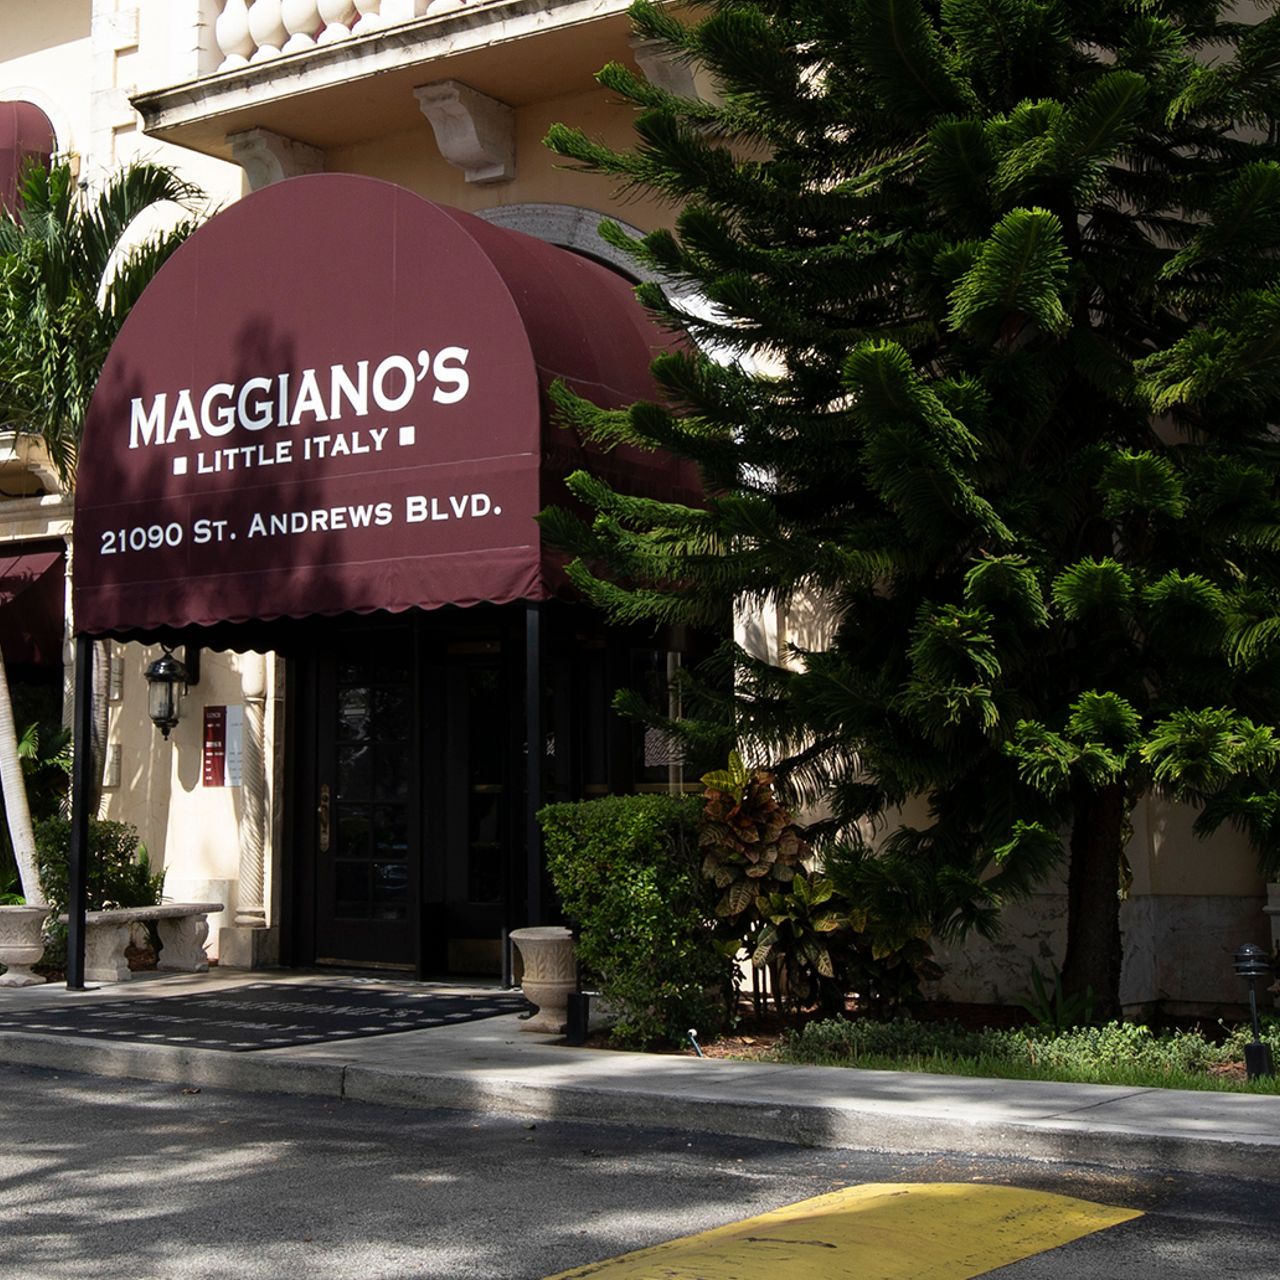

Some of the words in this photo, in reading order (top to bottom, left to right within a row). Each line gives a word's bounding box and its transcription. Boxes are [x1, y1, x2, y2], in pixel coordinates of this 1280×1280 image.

[128, 346, 470, 450] MAGGIANO'S
[197, 440, 293, 475] LITTLE
[304, 427, 389, 461] ITALY
[100, 522, 183, 555] 21090
[193, 519, 237, 544] ST.
[248, 502, 393, 539] ANDREWS
[405, 493, 503, 524] BLVD.
